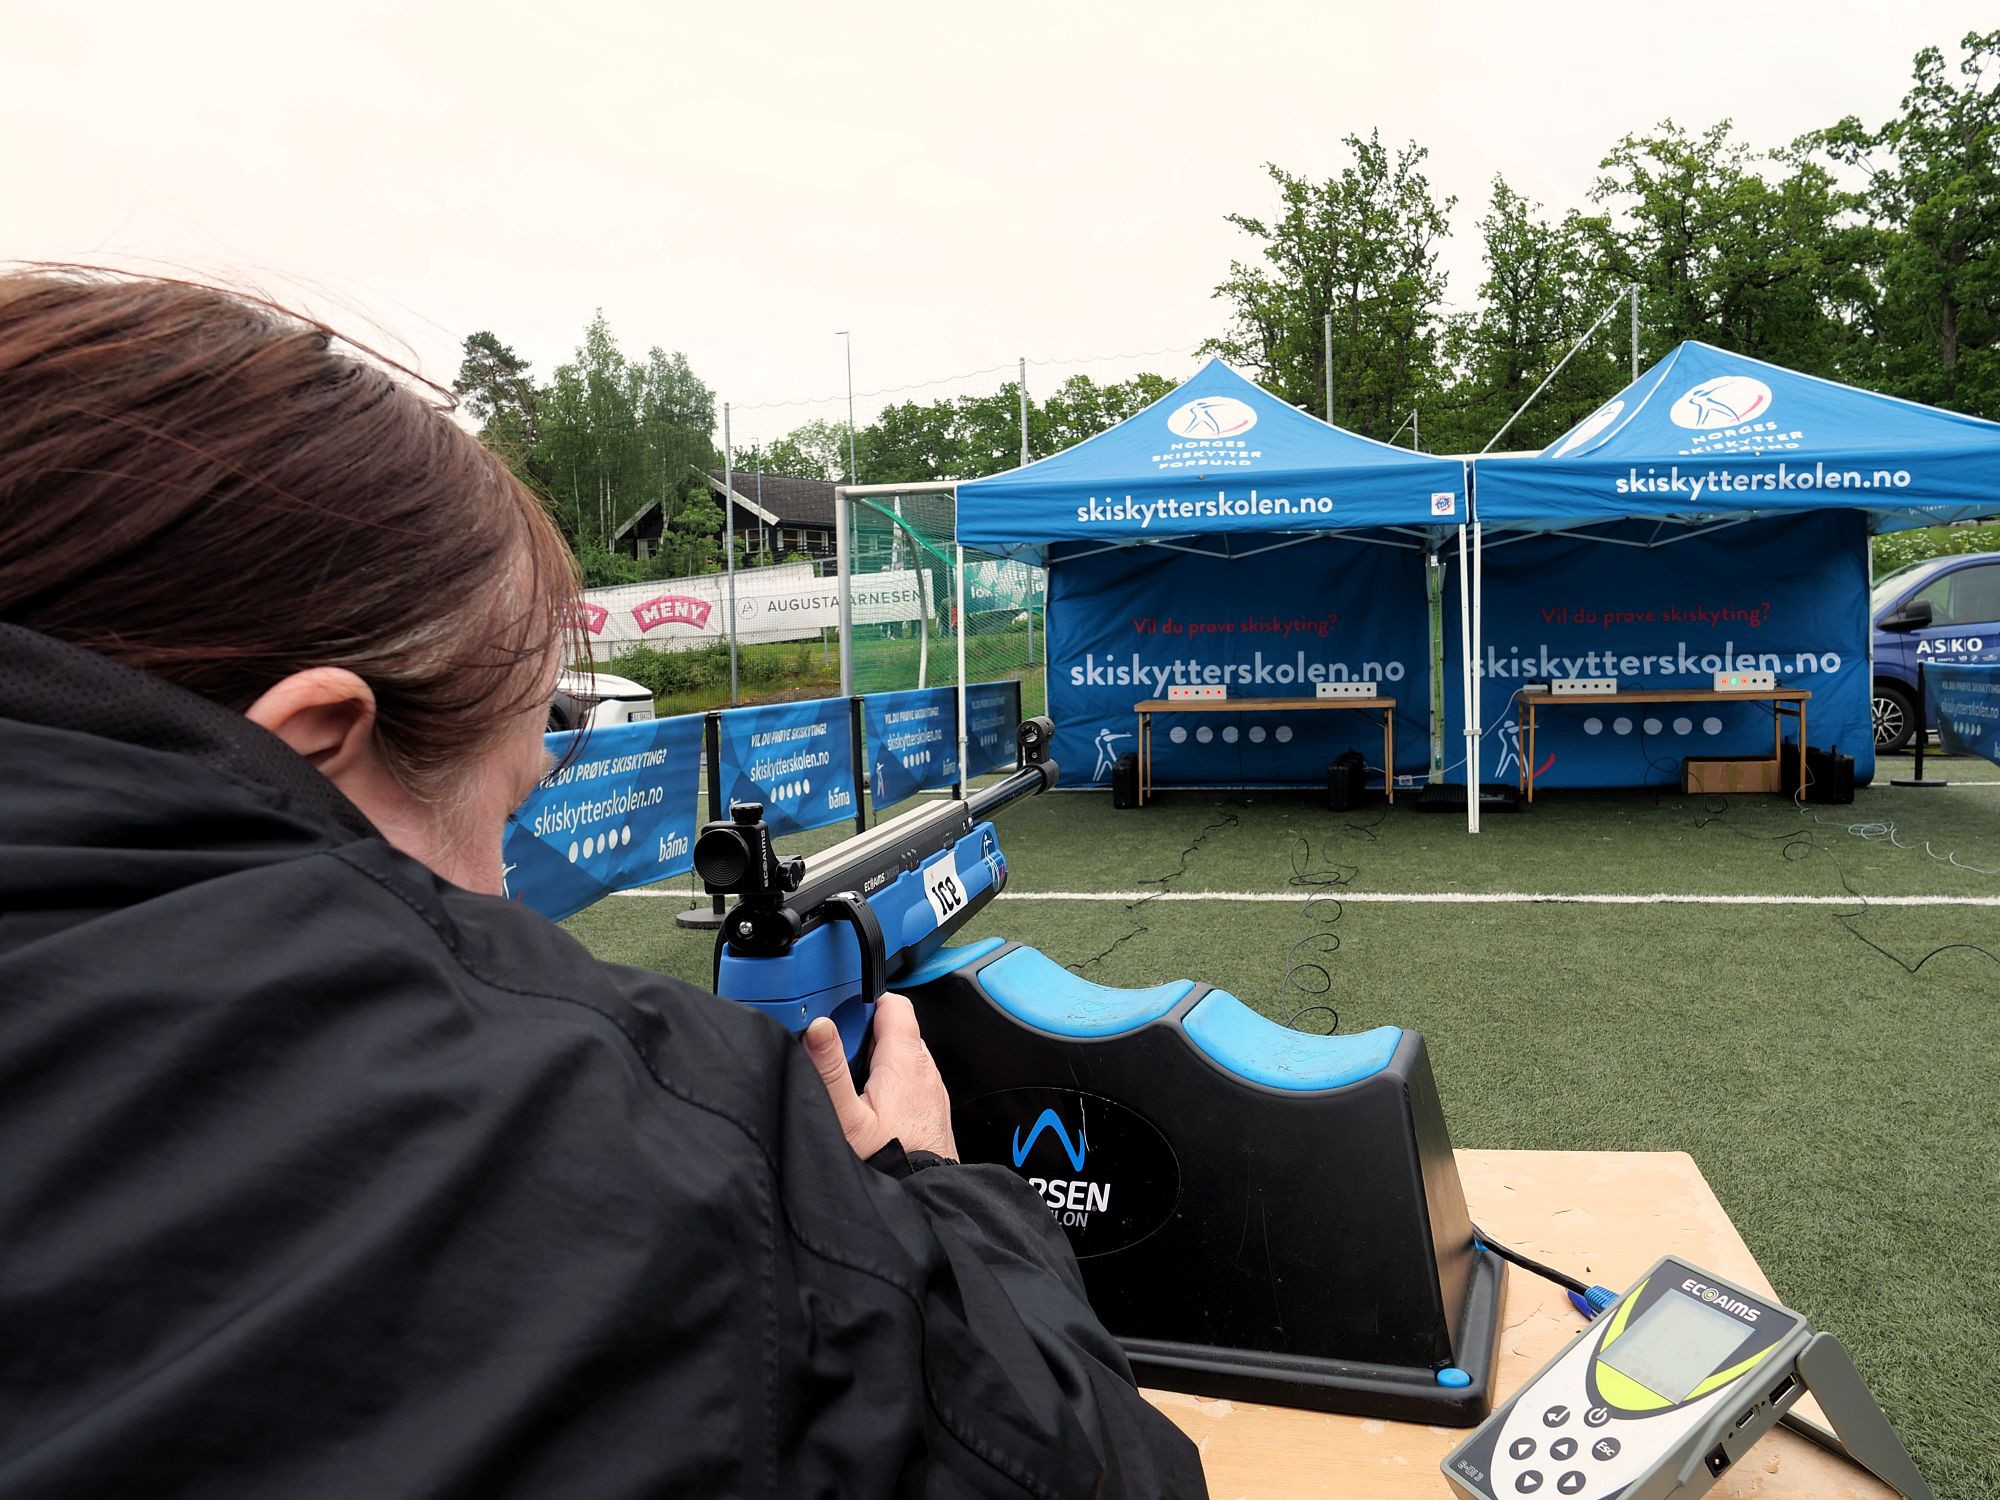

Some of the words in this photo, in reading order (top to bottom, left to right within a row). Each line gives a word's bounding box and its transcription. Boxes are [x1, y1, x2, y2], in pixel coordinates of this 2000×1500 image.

[1171, 440, 1247, 450] NORGES
[1691, 421, 1778, 444] NORGES
[1151, 450, 1262, 462] SKISKYTTER
[1616, 462, 1912, 501] skiskytterskolen.no
[1077, 489, 1334, 528] skiskytterskolen.no
[640, 601, 707, 624] MENY
[767, 595, 840, 613] AUGUSTA
[850, 590, 920, 606] ARNESEN
[1133, 618, 1156, 635] Vil
[1161, 618, 1183, 634] du
[1240, 614, 1339, 639] skiskyting?
[1540, 606, 1567, 625] Vil
[1574, 607, 1597, 625] du
[1662, 602, 1772, 628] skiskyting?
[1070, 651, 1405, 698] skiskytterskolen.no
[751, 734, 760, 748] VIL
[761, 731, 771, 746] DU
[771, 728, 792, 745] PRØVE
[791, 722, 827, 741] SKISKYTING?
[557, 766, 575, 786] DU
[575, 759, 611, 782] PRØVE
[611, 748, 668, 775] SKISKYTING?
[750, 749, 830, 782] skiskytterskolen.no
[533, 785, 664, 838] skiskytterskolen.no
[1028, 1177, 1111, 1213] RSEN
[1595, 1441, 1616, 1457] Esc
